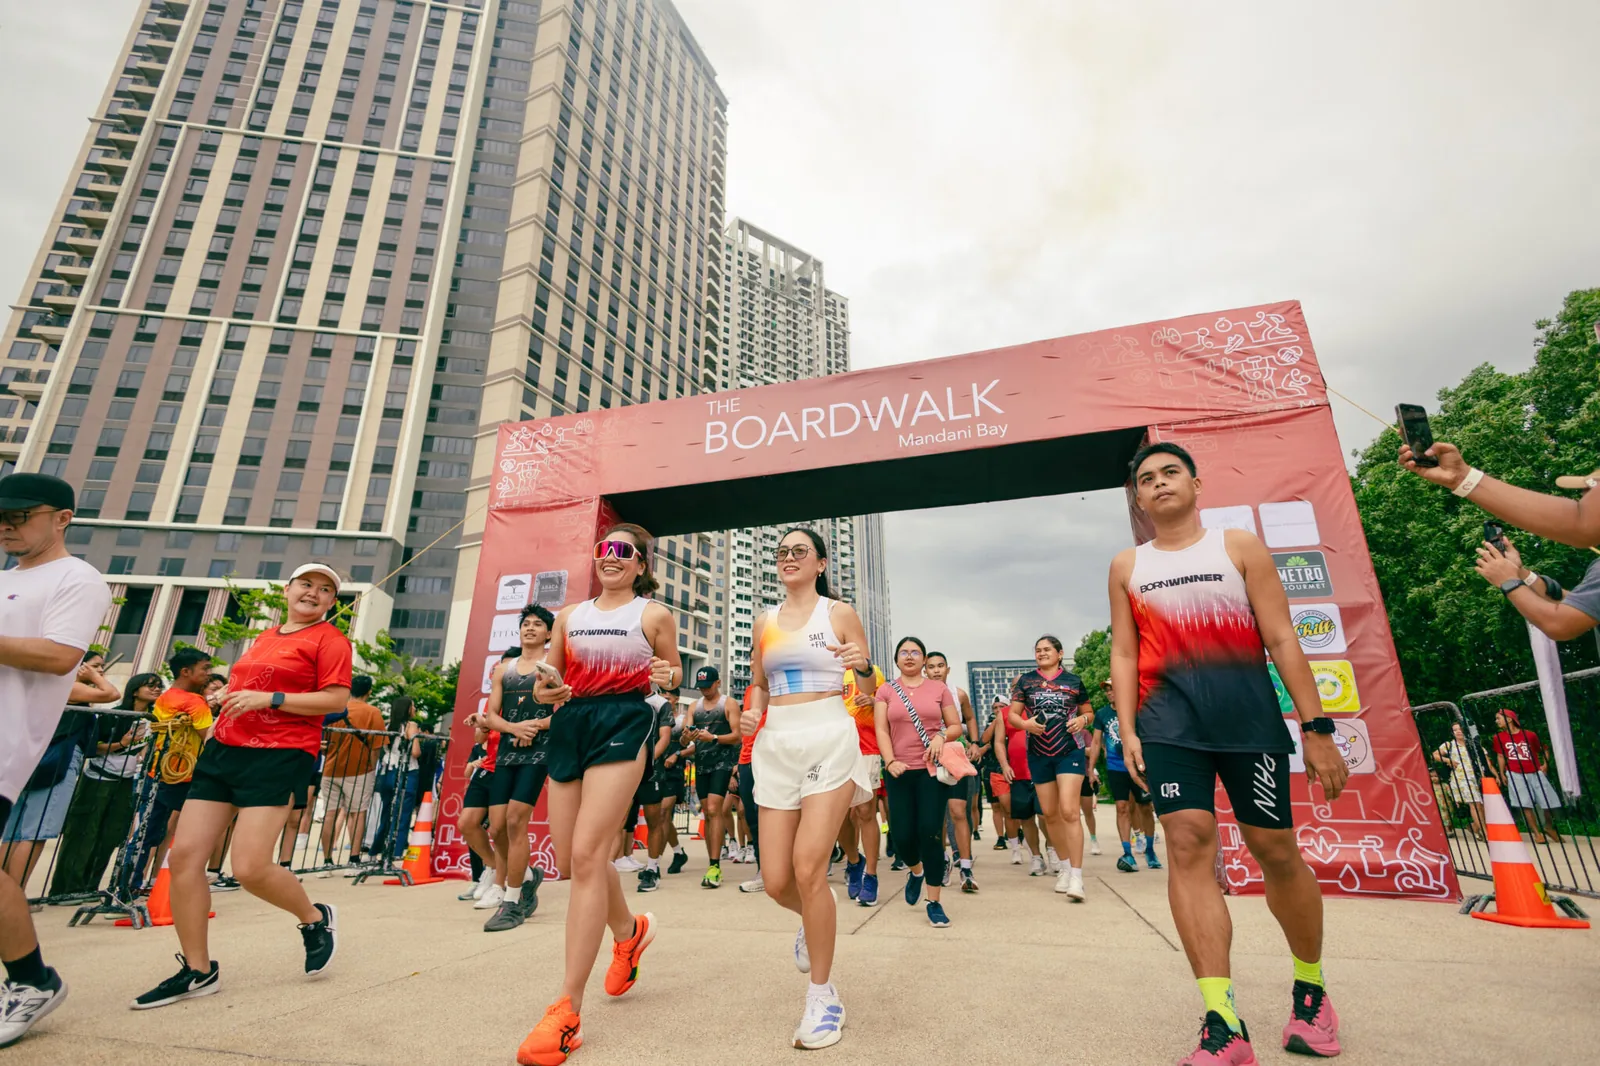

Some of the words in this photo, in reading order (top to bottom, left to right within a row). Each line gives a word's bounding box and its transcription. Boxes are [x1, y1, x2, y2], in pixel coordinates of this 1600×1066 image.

[706, 398, 741, 416] THE
[704, 379, 1005, 454] BOARDWALK
[899, 425, 972, 448] Mandani
[976, 423, 1008, 439] Bay
[1277, 567, 1324, 582] METRO
[808, 632, 825, 641] SALT
[1293, 620, 1336, 639] Chill
